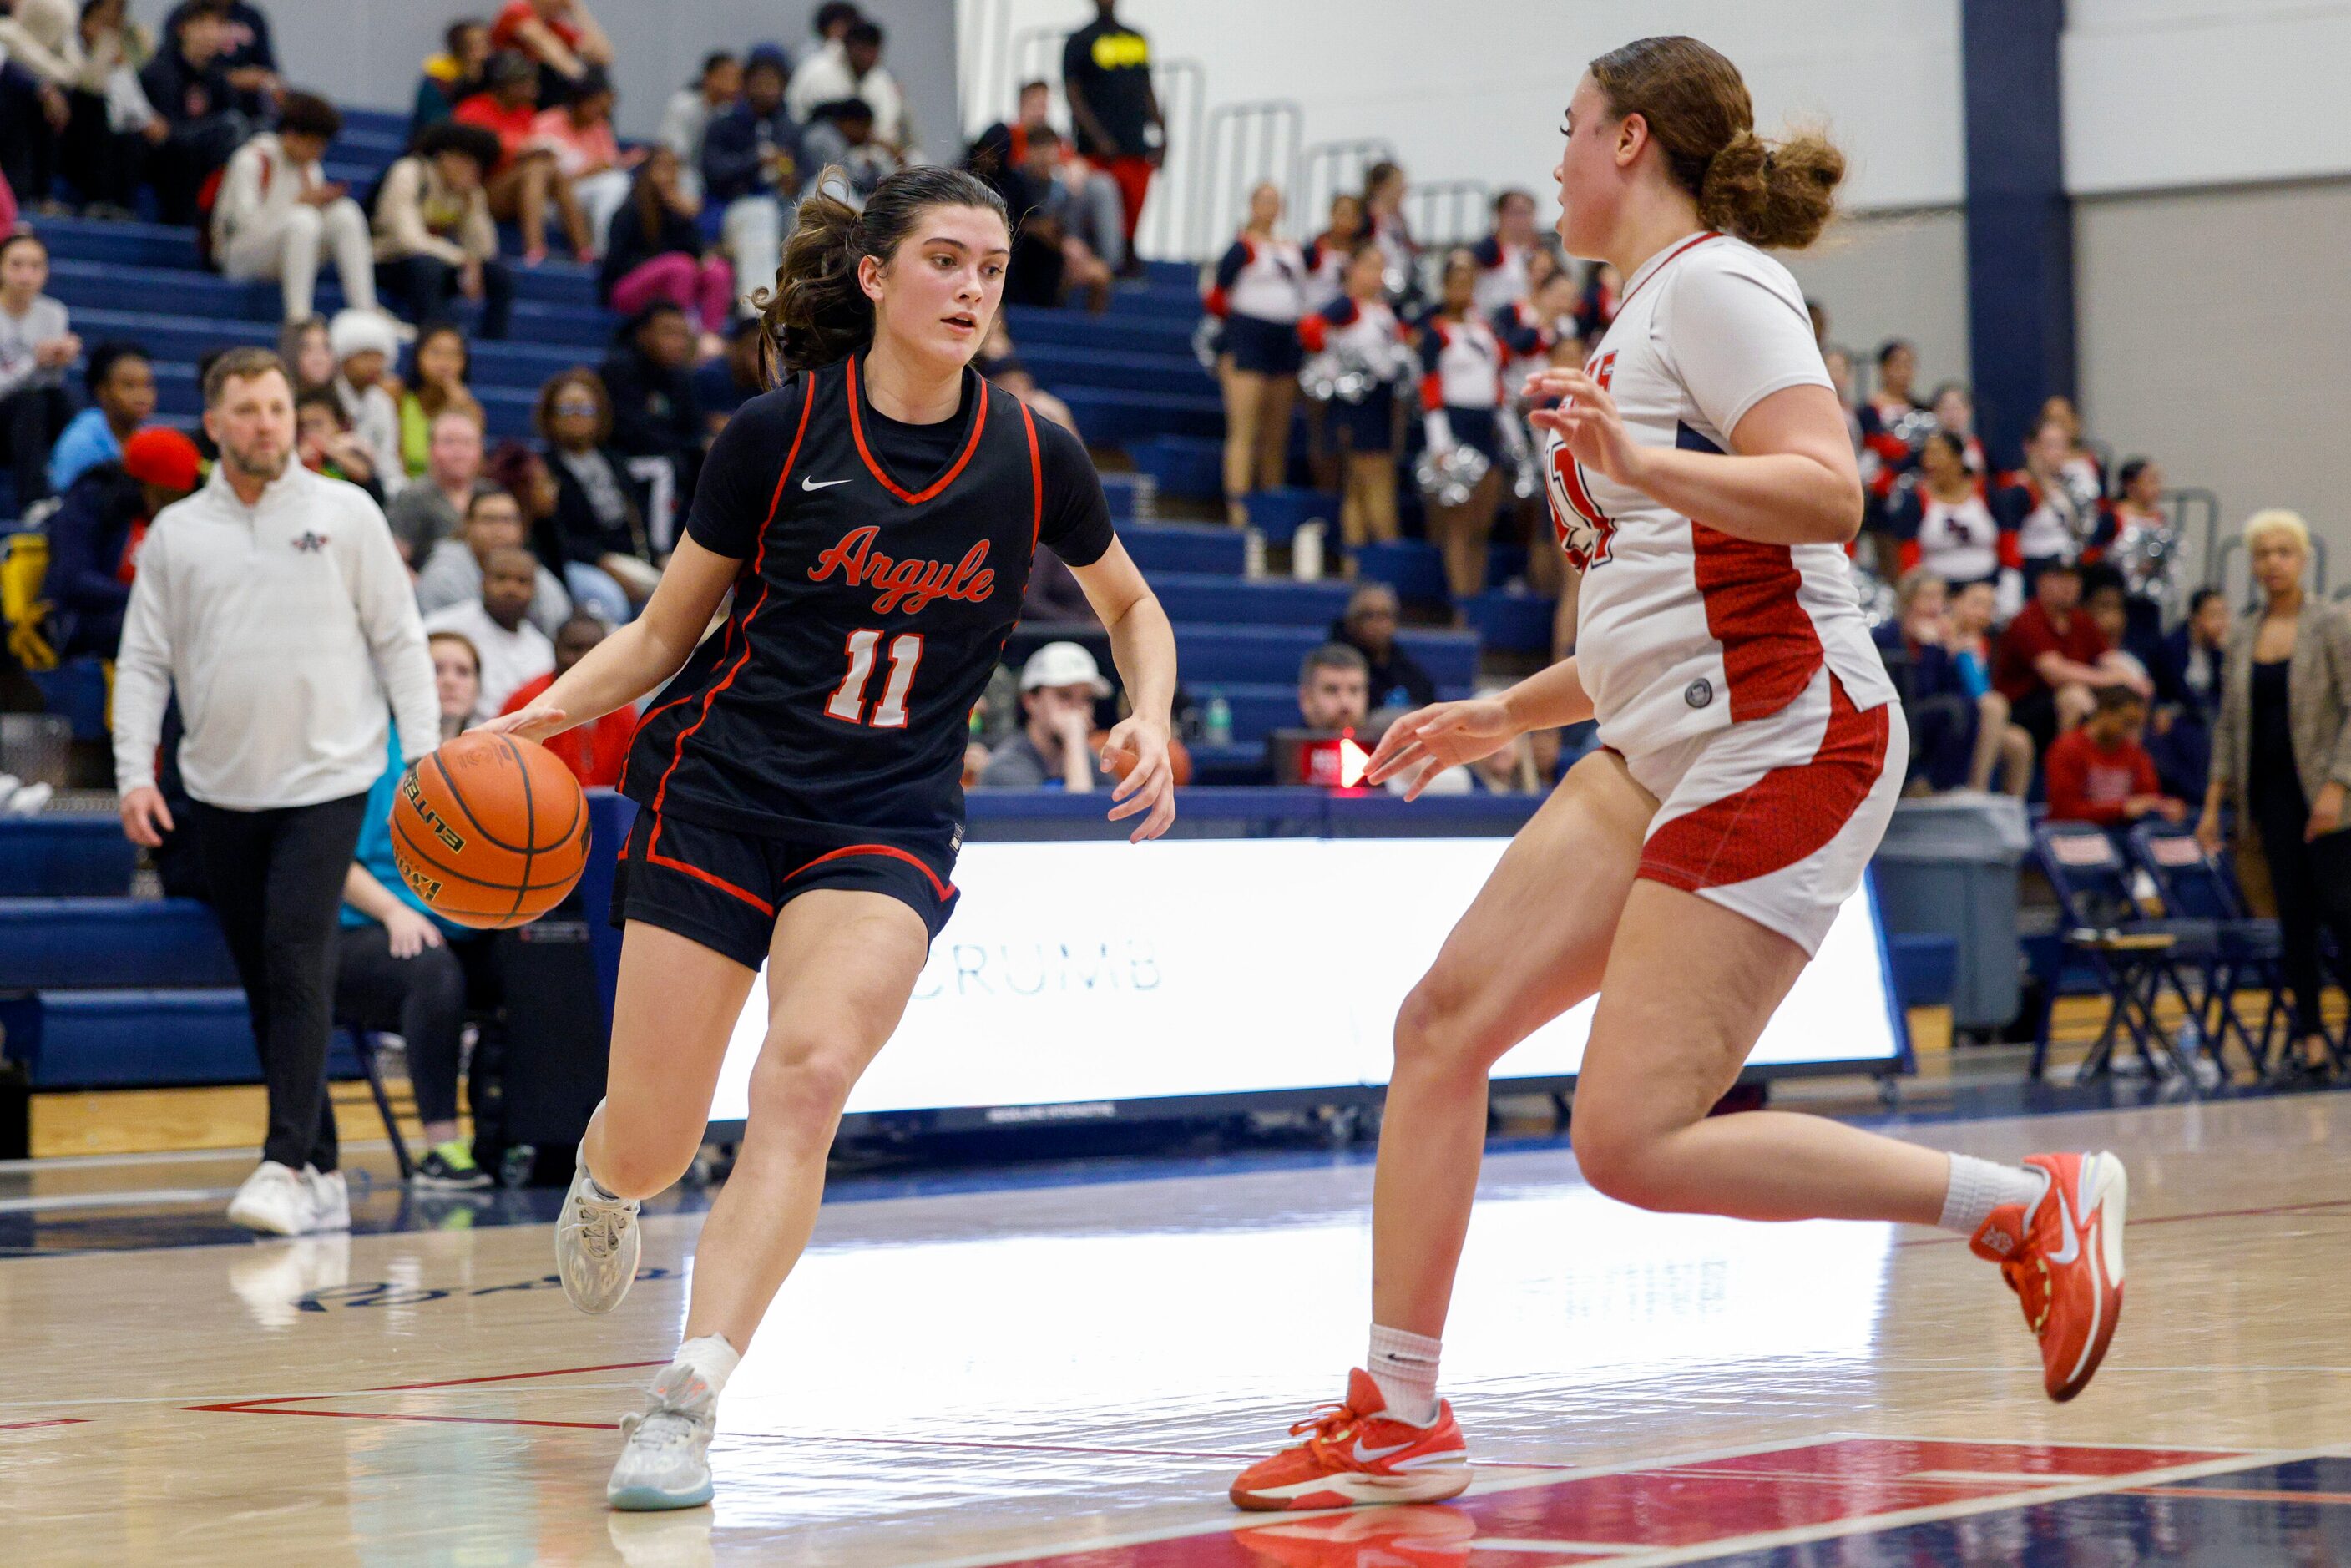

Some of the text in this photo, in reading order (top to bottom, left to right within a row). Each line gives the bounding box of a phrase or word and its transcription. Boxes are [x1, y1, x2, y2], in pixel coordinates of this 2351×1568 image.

[807, 525, 995, 615] Argyle
[823, 627, 925, 729] 11
[406, 780, 468, 856] ELITE
